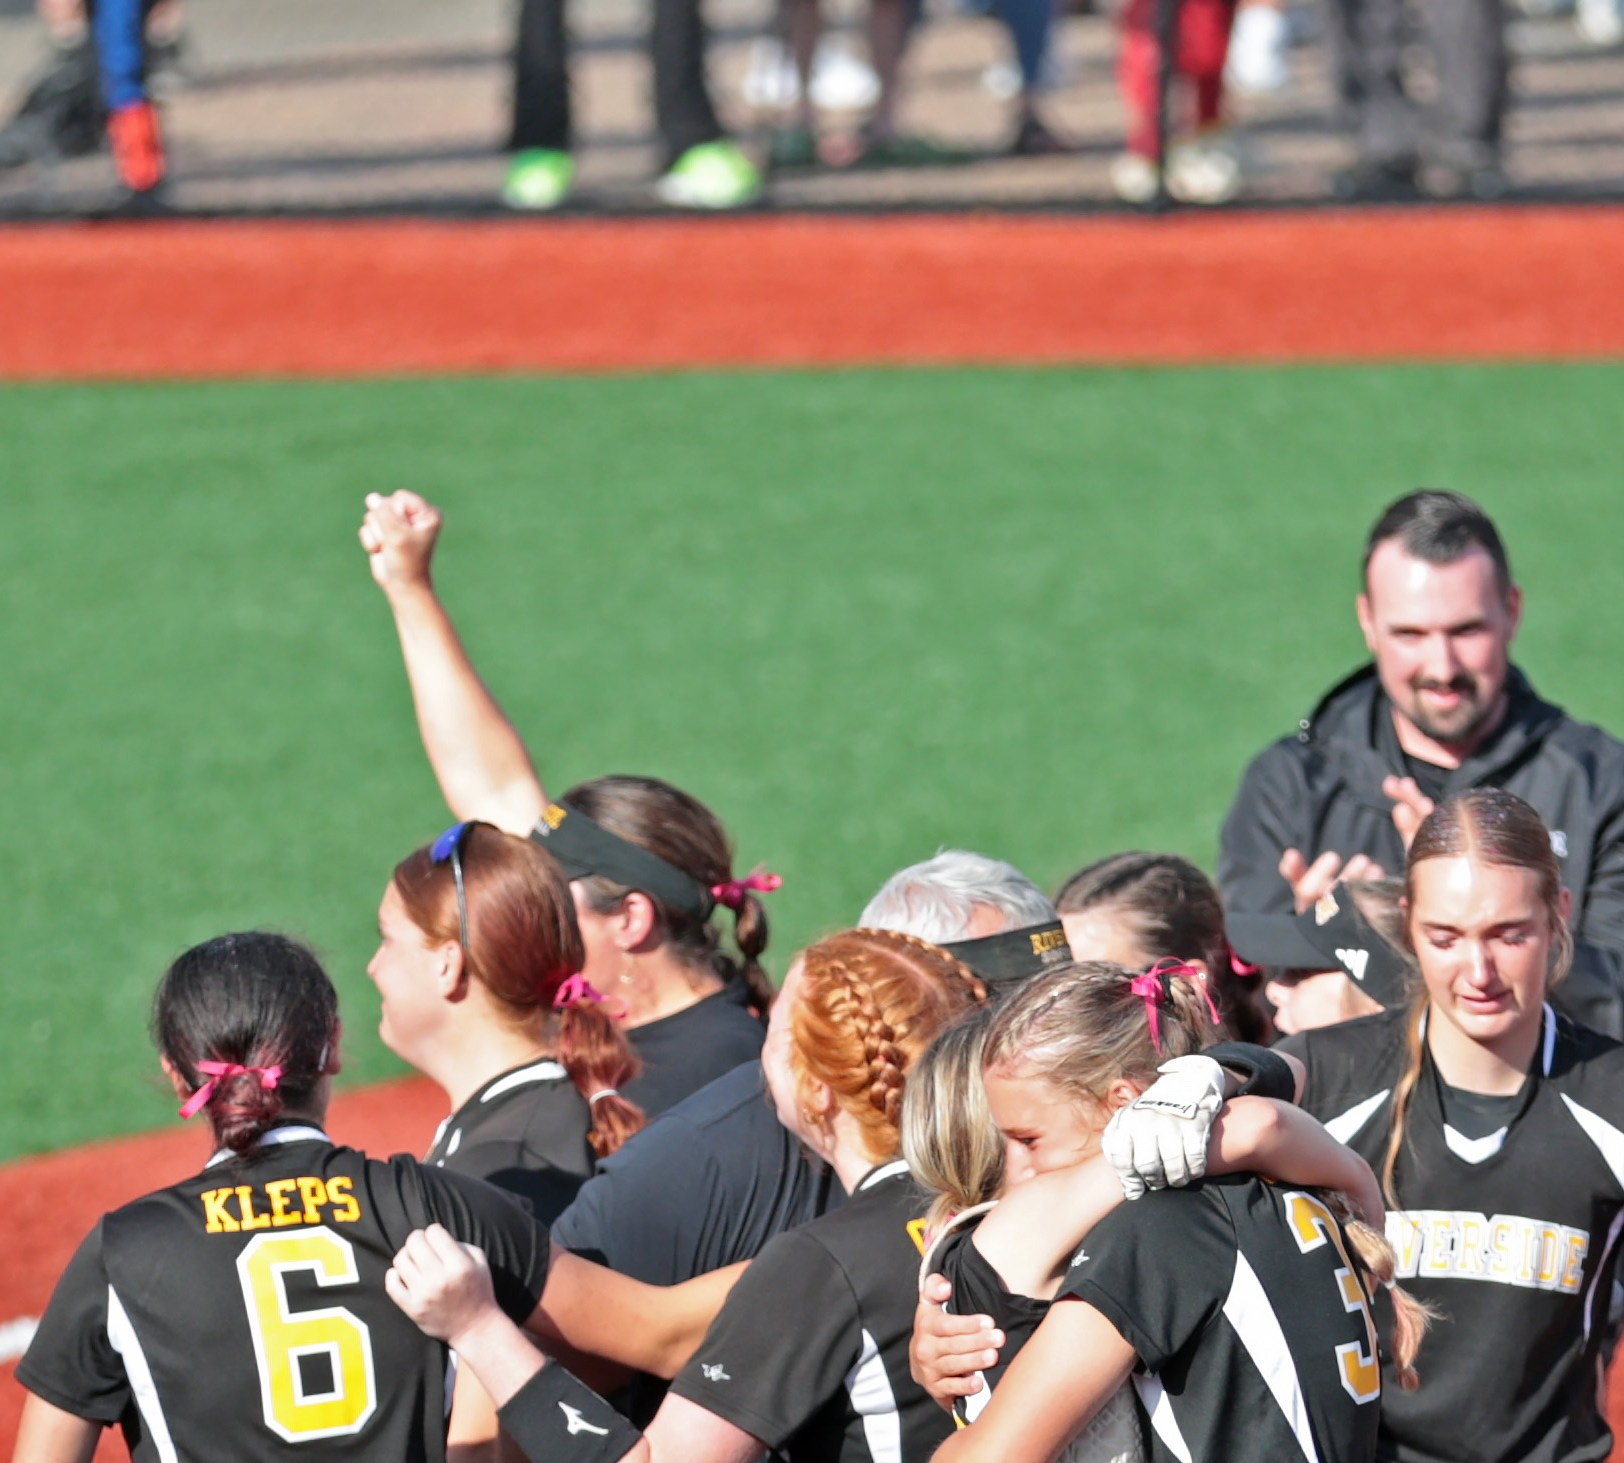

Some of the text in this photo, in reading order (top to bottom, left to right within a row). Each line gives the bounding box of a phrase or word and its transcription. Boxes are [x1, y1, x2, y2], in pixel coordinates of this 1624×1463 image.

[200, 1176, 362, 1234] KLEPS
[1385, 1209, 1591, 1295] VERSIDE
[235, 1224, 377, 1444] 6
